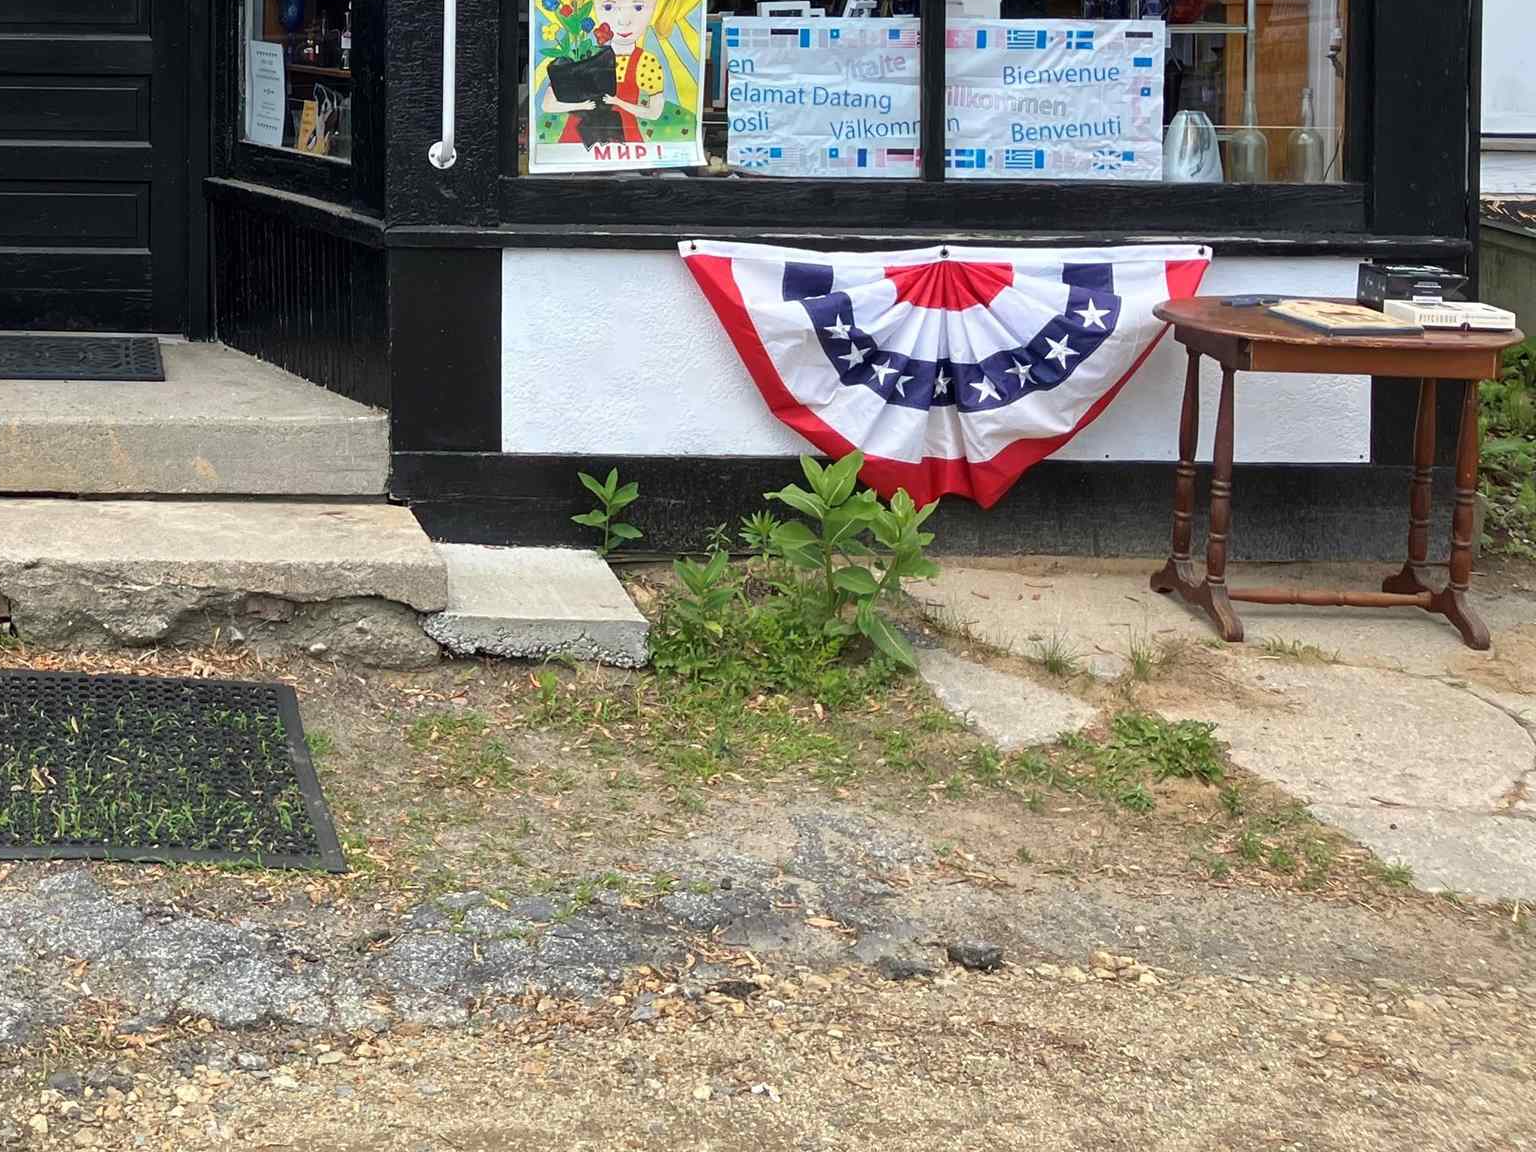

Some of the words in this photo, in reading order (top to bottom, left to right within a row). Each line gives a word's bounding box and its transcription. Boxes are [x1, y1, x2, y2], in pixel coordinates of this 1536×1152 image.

[1003, 66, 1120, 85] Bienvenue
[730, 82, 805, 105] elamat
[813, 86, 892, 114] Datang
[946, 84, 1067, 116] illkommen
[1011, 115, 1121, 142] Benvenuti
